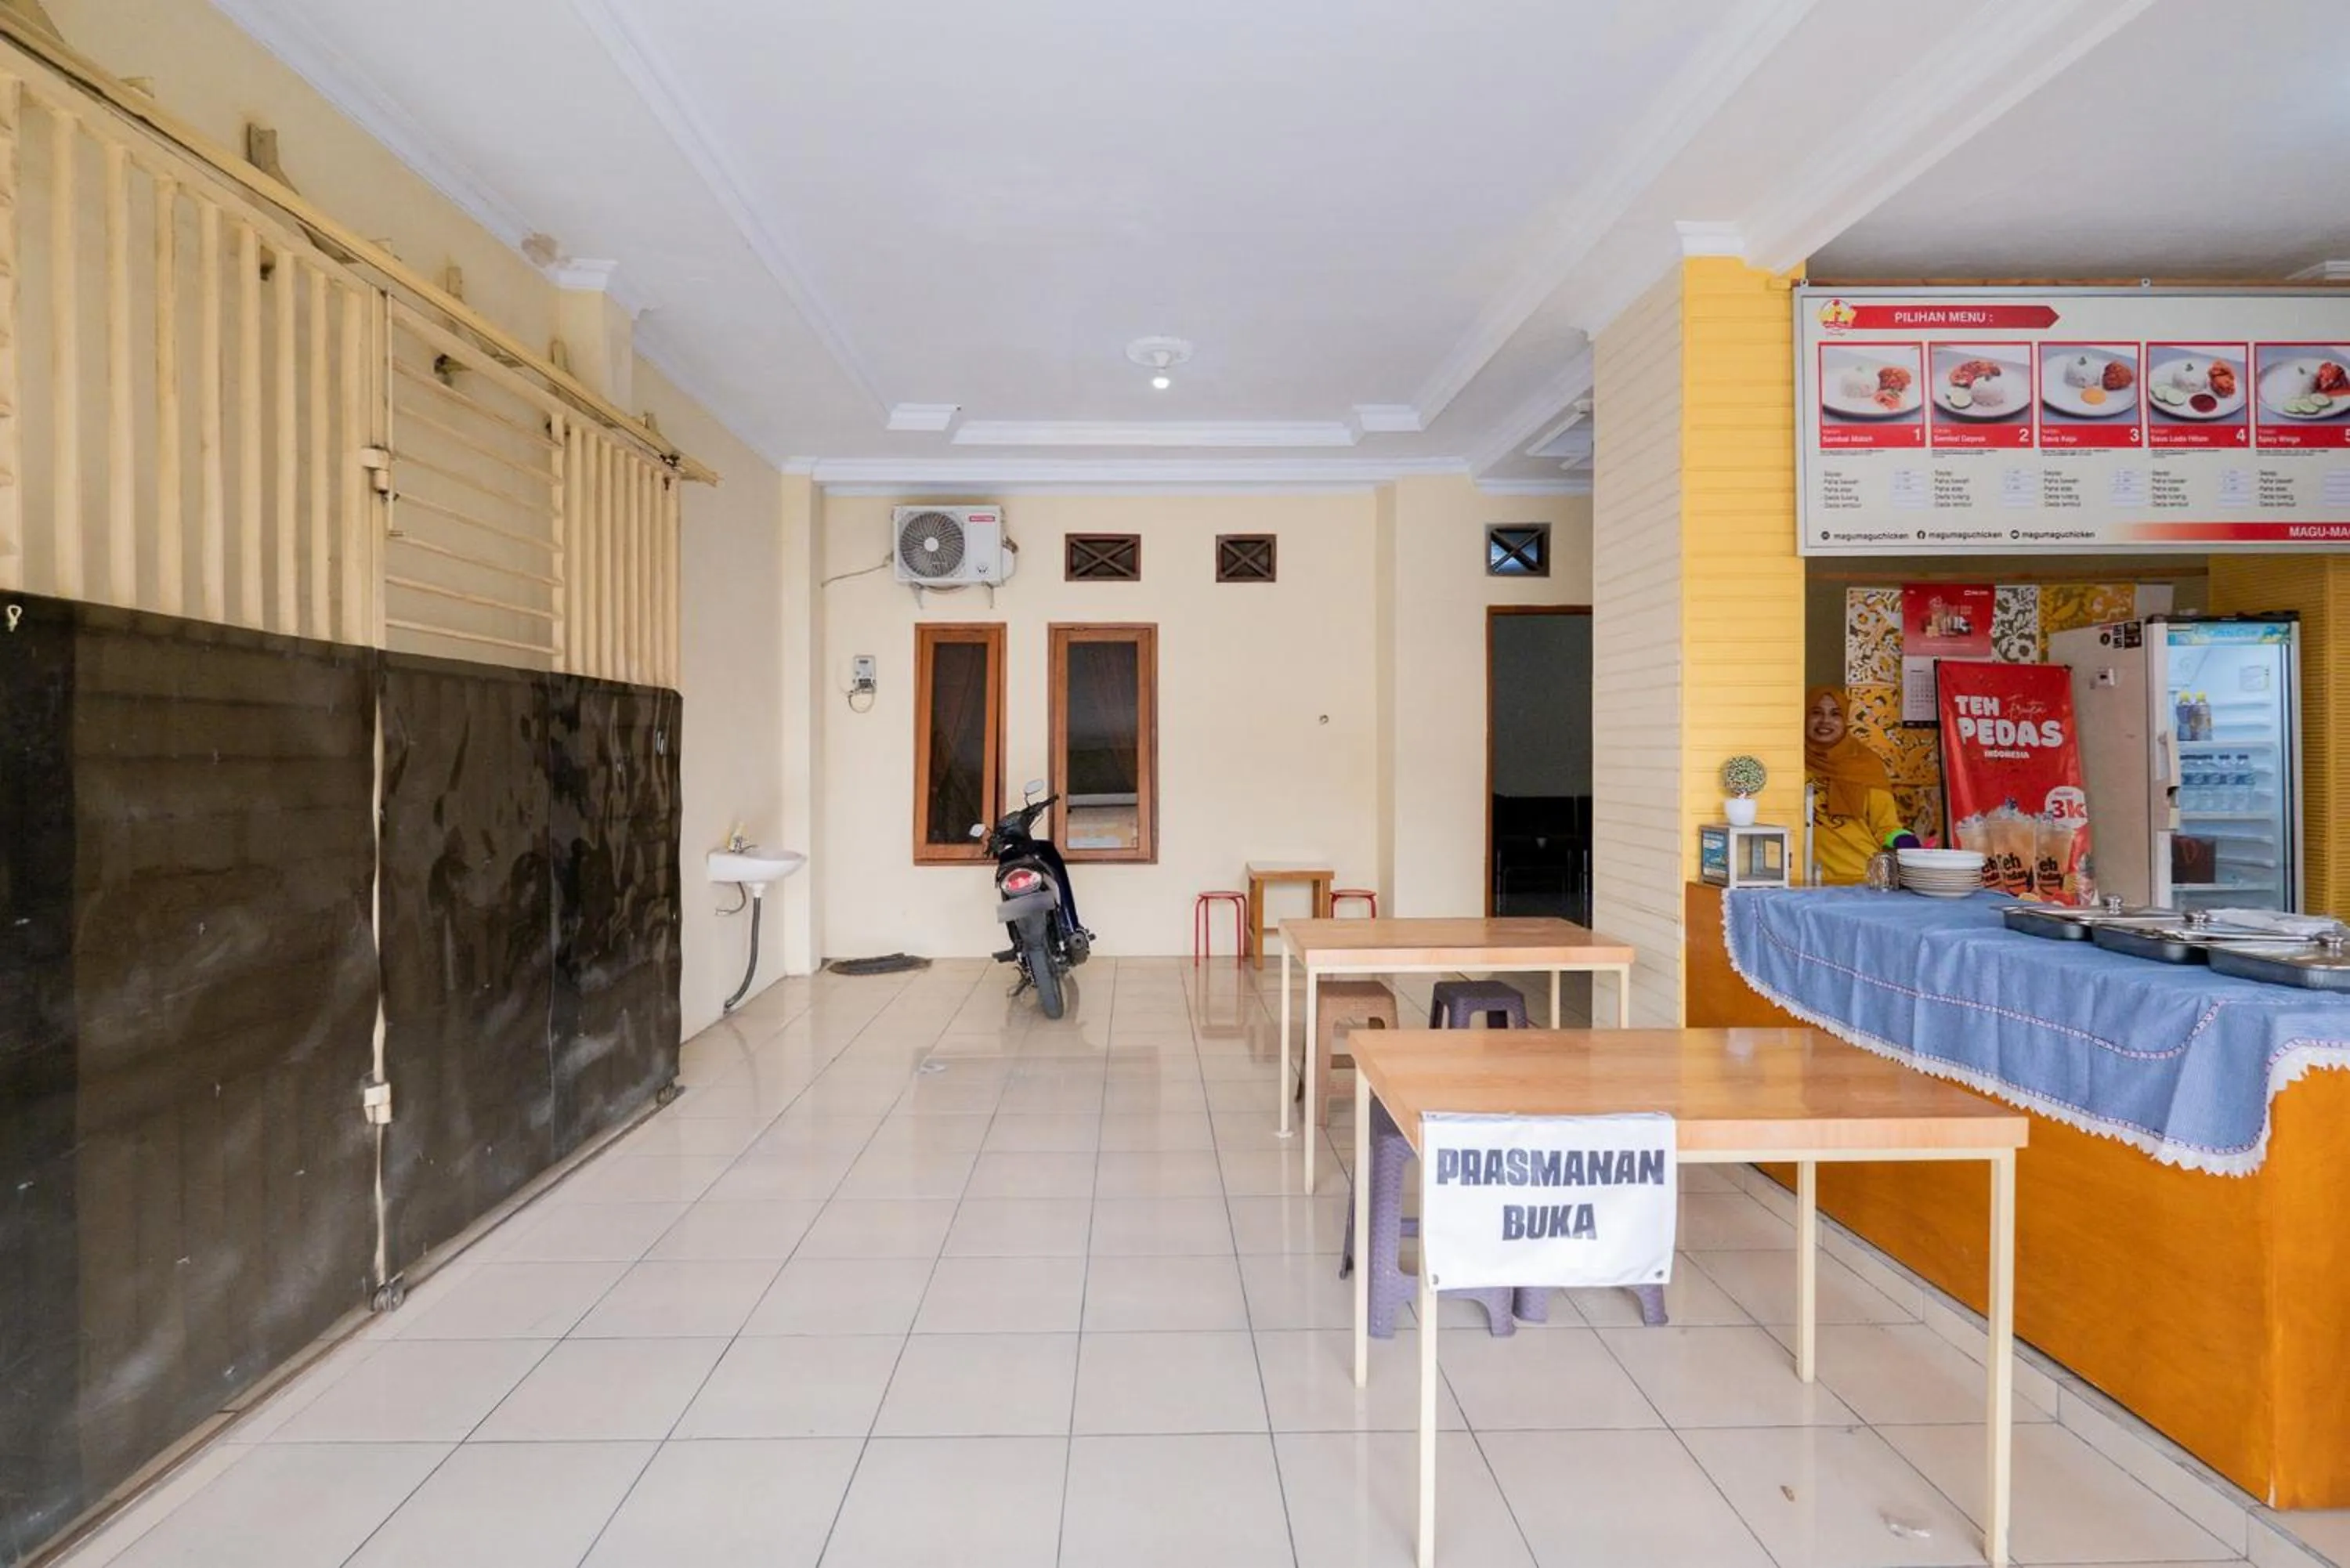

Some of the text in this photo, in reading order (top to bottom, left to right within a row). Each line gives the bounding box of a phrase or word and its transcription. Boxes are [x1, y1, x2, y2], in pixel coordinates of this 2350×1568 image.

[1895, 312, 1946, 323] PILIHAN
[1949, 312, 1986, 323] MENU
[1914, 428, 1920, 441] 1
[2019, 428, 2029, 442] 2
[2131, 428, 2139, 442] 3
[2236, 428, 2246, 442] 4
[1834, 531, 1910, 541] magumaguchicken
[1928, 529, 2003, 540] magumaguchicken
[2022, 529, 2095, 540] magumaguchicken
[2289, 526, 2350, 537] MAGU-MA
[1954, 695, 2000, 716] TEH
[1957, 717, 2064, 748] PEDAS
[1984, 750, 2030, 759] INDONESIA
[1437, 1148, 1665, 1187] PRASMANAN
[1502, 1203, 1597, 1241] BUKA
